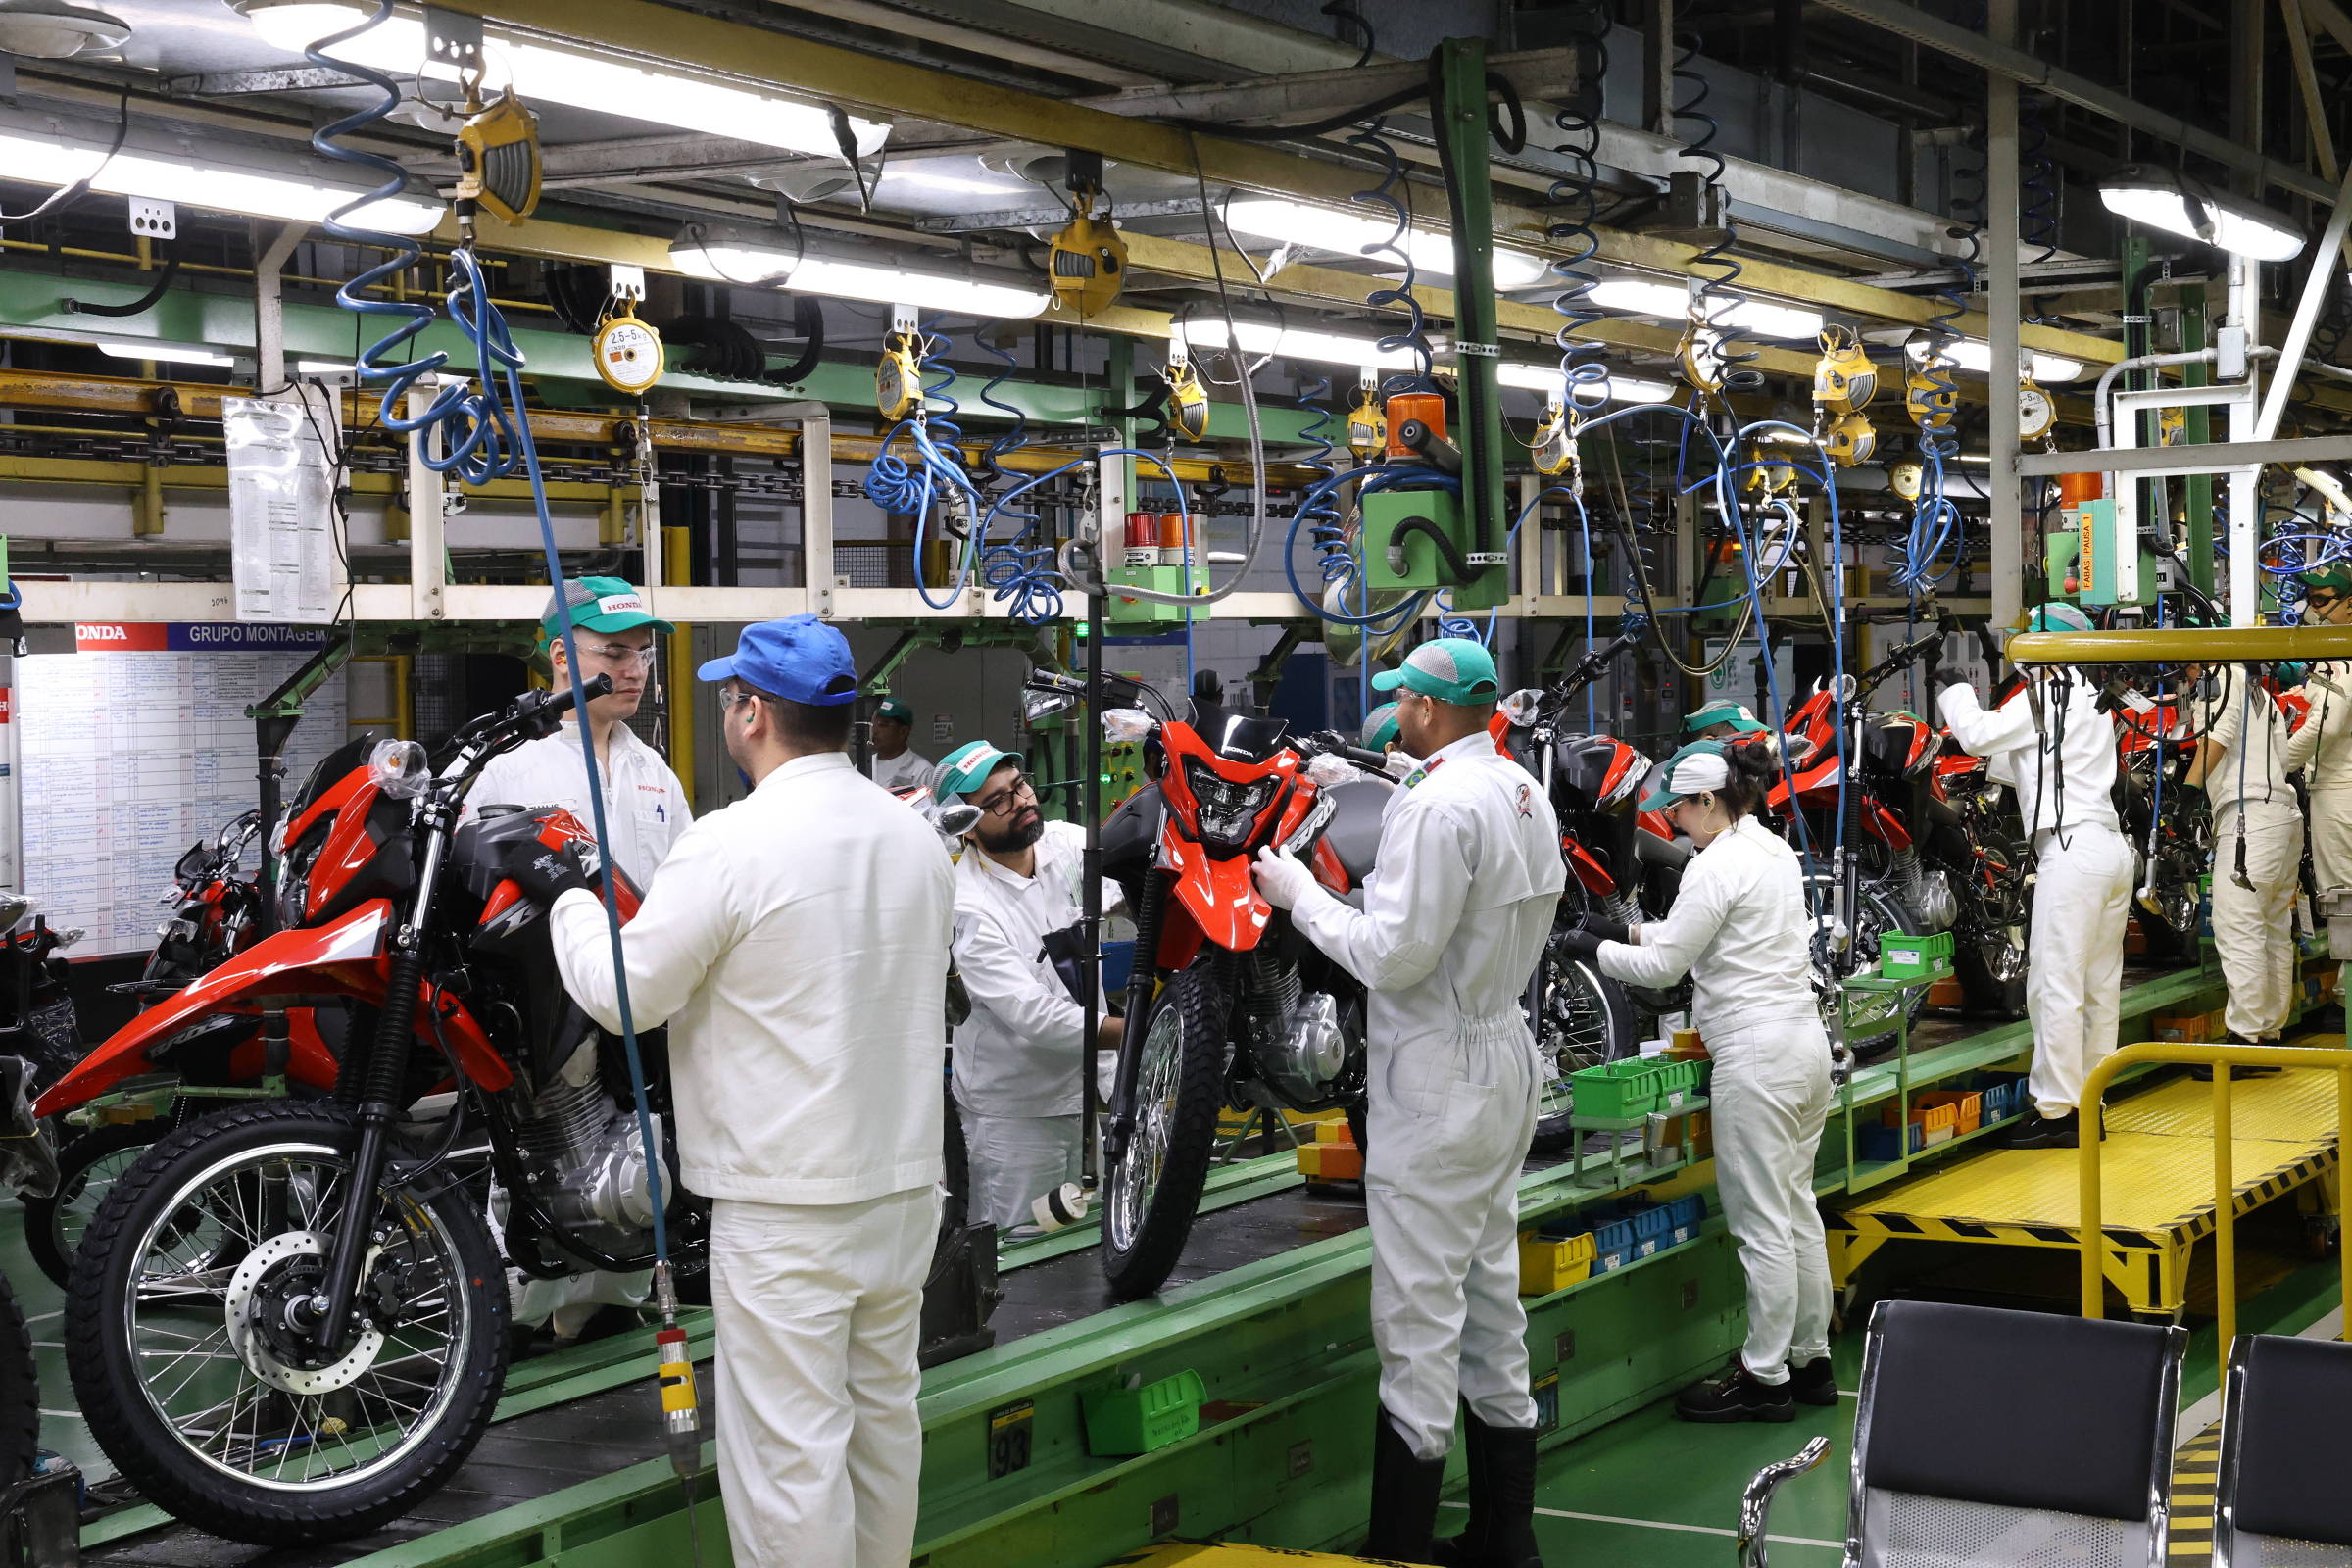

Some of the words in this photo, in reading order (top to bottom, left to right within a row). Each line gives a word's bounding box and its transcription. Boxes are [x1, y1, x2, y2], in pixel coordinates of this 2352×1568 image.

[76, 625, 127, 640] ONDA
[190, 626, 242, 642] GRUPO
[1223, 745, 1254, 758] HONDA
